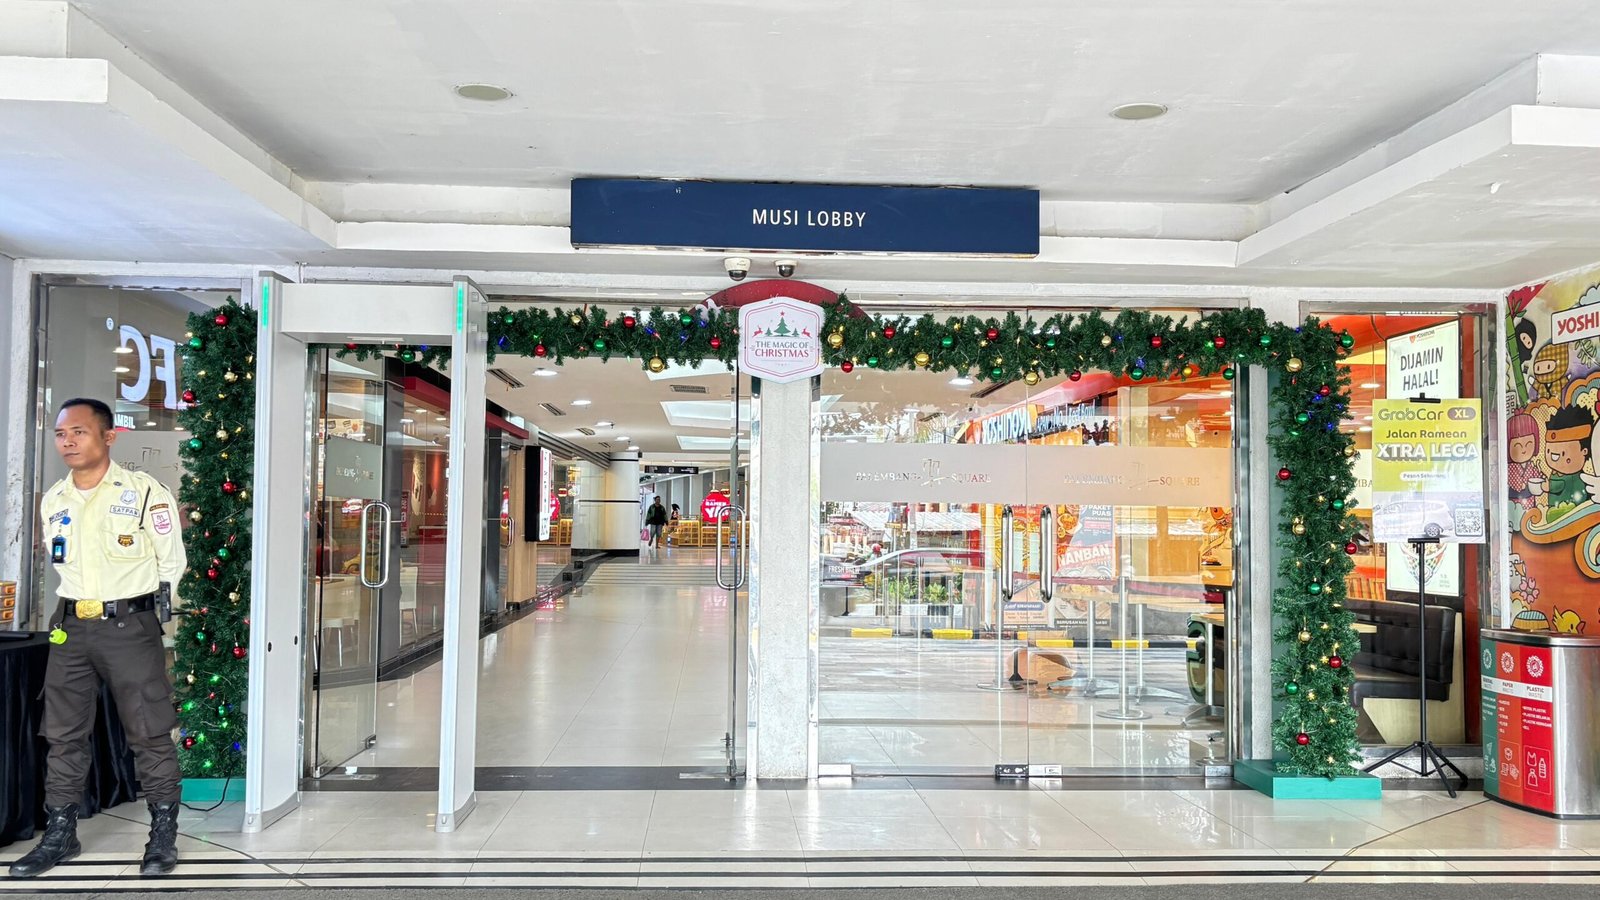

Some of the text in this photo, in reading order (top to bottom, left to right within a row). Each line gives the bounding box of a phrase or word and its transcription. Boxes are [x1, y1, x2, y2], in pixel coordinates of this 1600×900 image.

[752, 208, 866, 227] MUSI LOBBY
[1557, 311, 1599, 336] YOSHI
[772, 341, 797, 349] MAGIC
[798, 341, 809, 349] OF
[754, 348, 809, 358] CHRISTMAS
[1400, 346, 1443, 371] DIJAMIN
[1403, 368, 1439, 391] HALAL!
[1378, 408, 1470, 421] GrabCar XL
[1386, 429, 1467, 439] Jalan Ramean
[1376, 443, 1479, 460] XTRA LEGA
[1159, 476, 1200, 487] SQRE
[1058, 544, 1110, 567] NANBAN
[1527, 685, 1545, 693] PLASTIC
